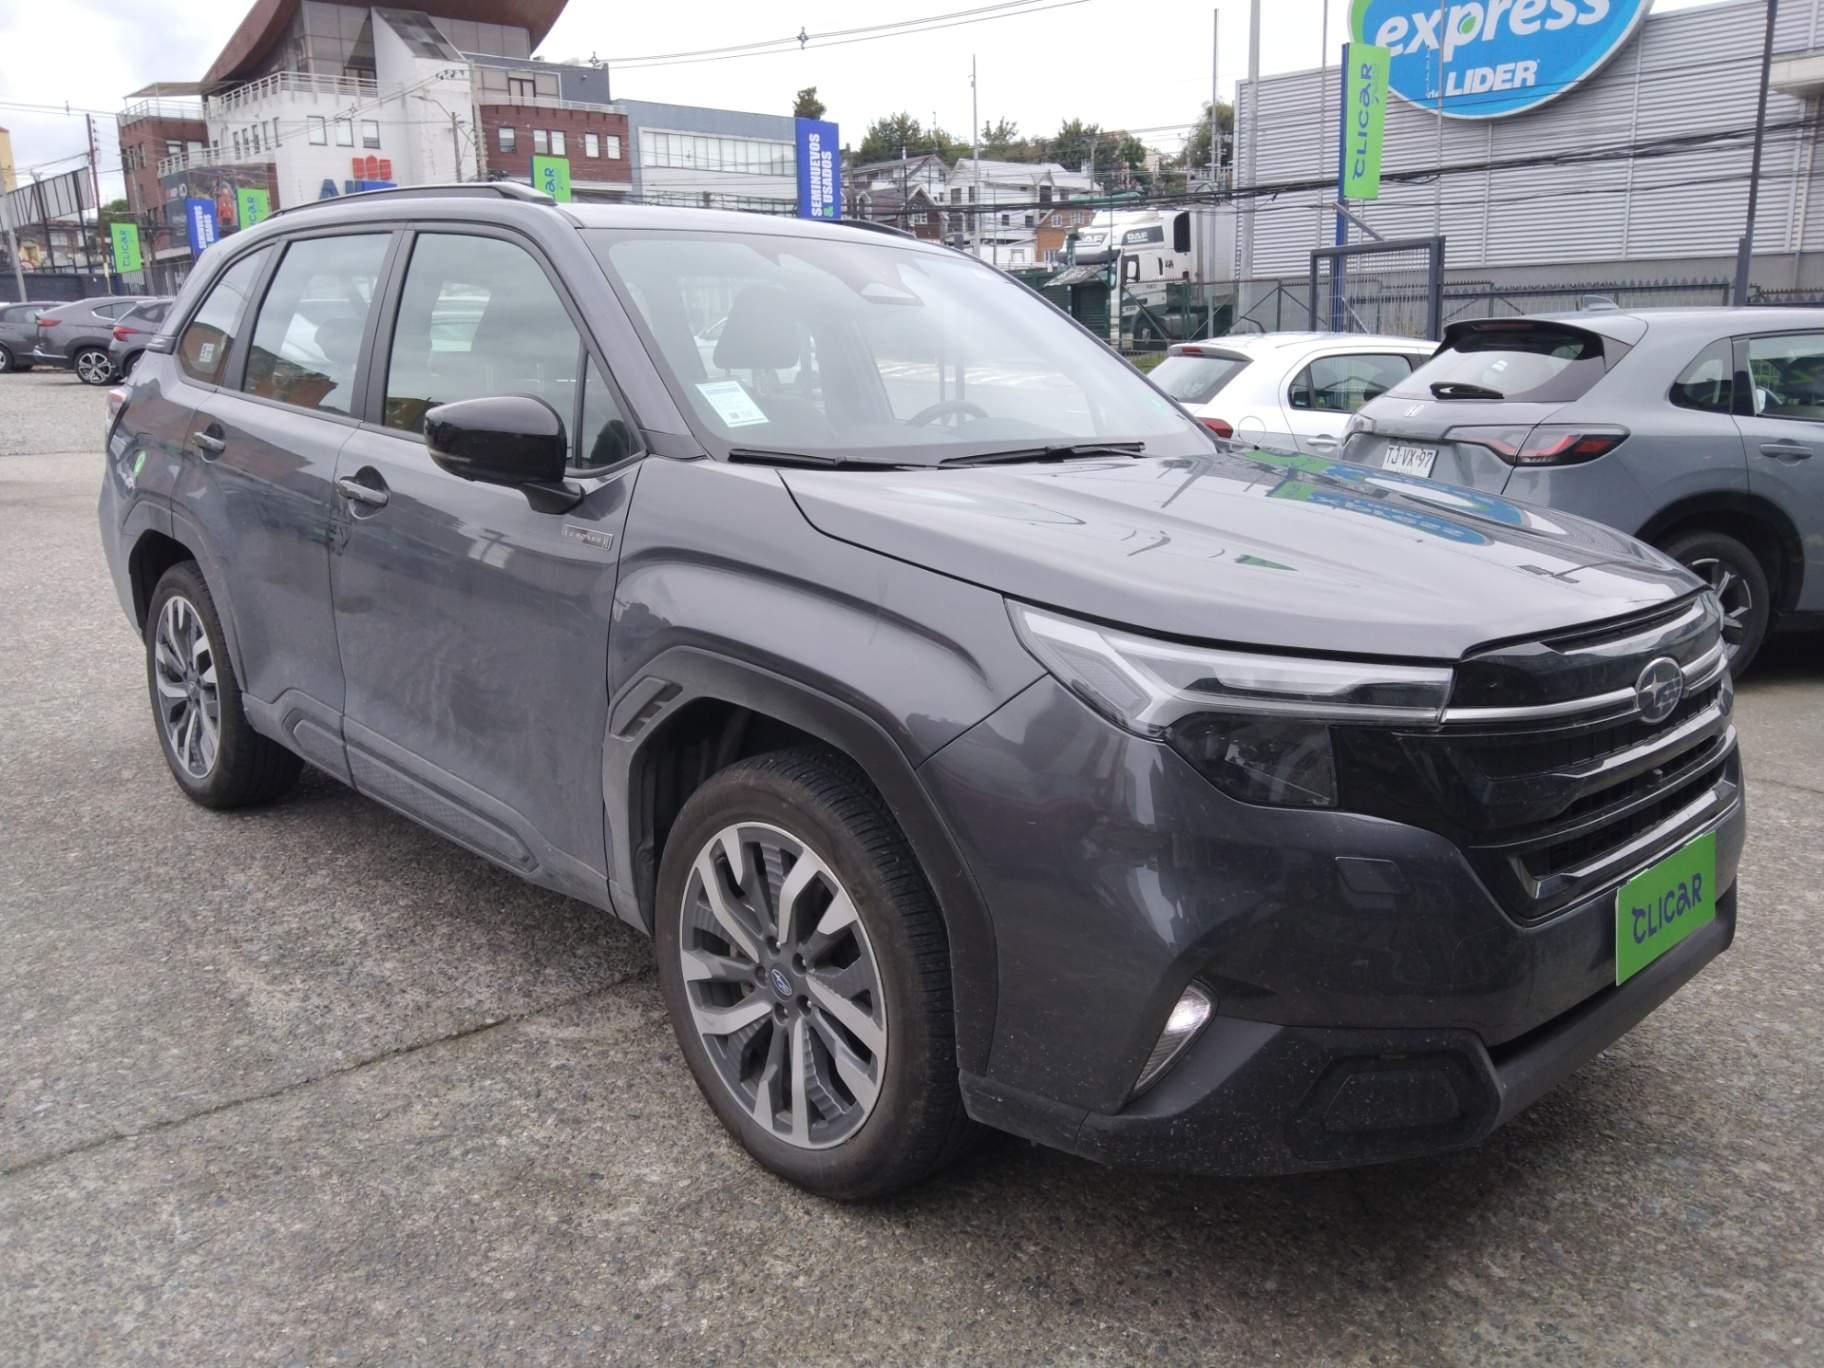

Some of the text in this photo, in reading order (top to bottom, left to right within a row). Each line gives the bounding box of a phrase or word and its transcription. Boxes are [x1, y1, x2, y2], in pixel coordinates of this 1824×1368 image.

[1376, 0, 1610, 62] express
[1445, 60, 1537, 97] LIDER
[809, 133, 822, 216] SEMINUEVOS
[821, 151, 833, 203] USADOS
[1126, 231, 1148, 241] DAF
